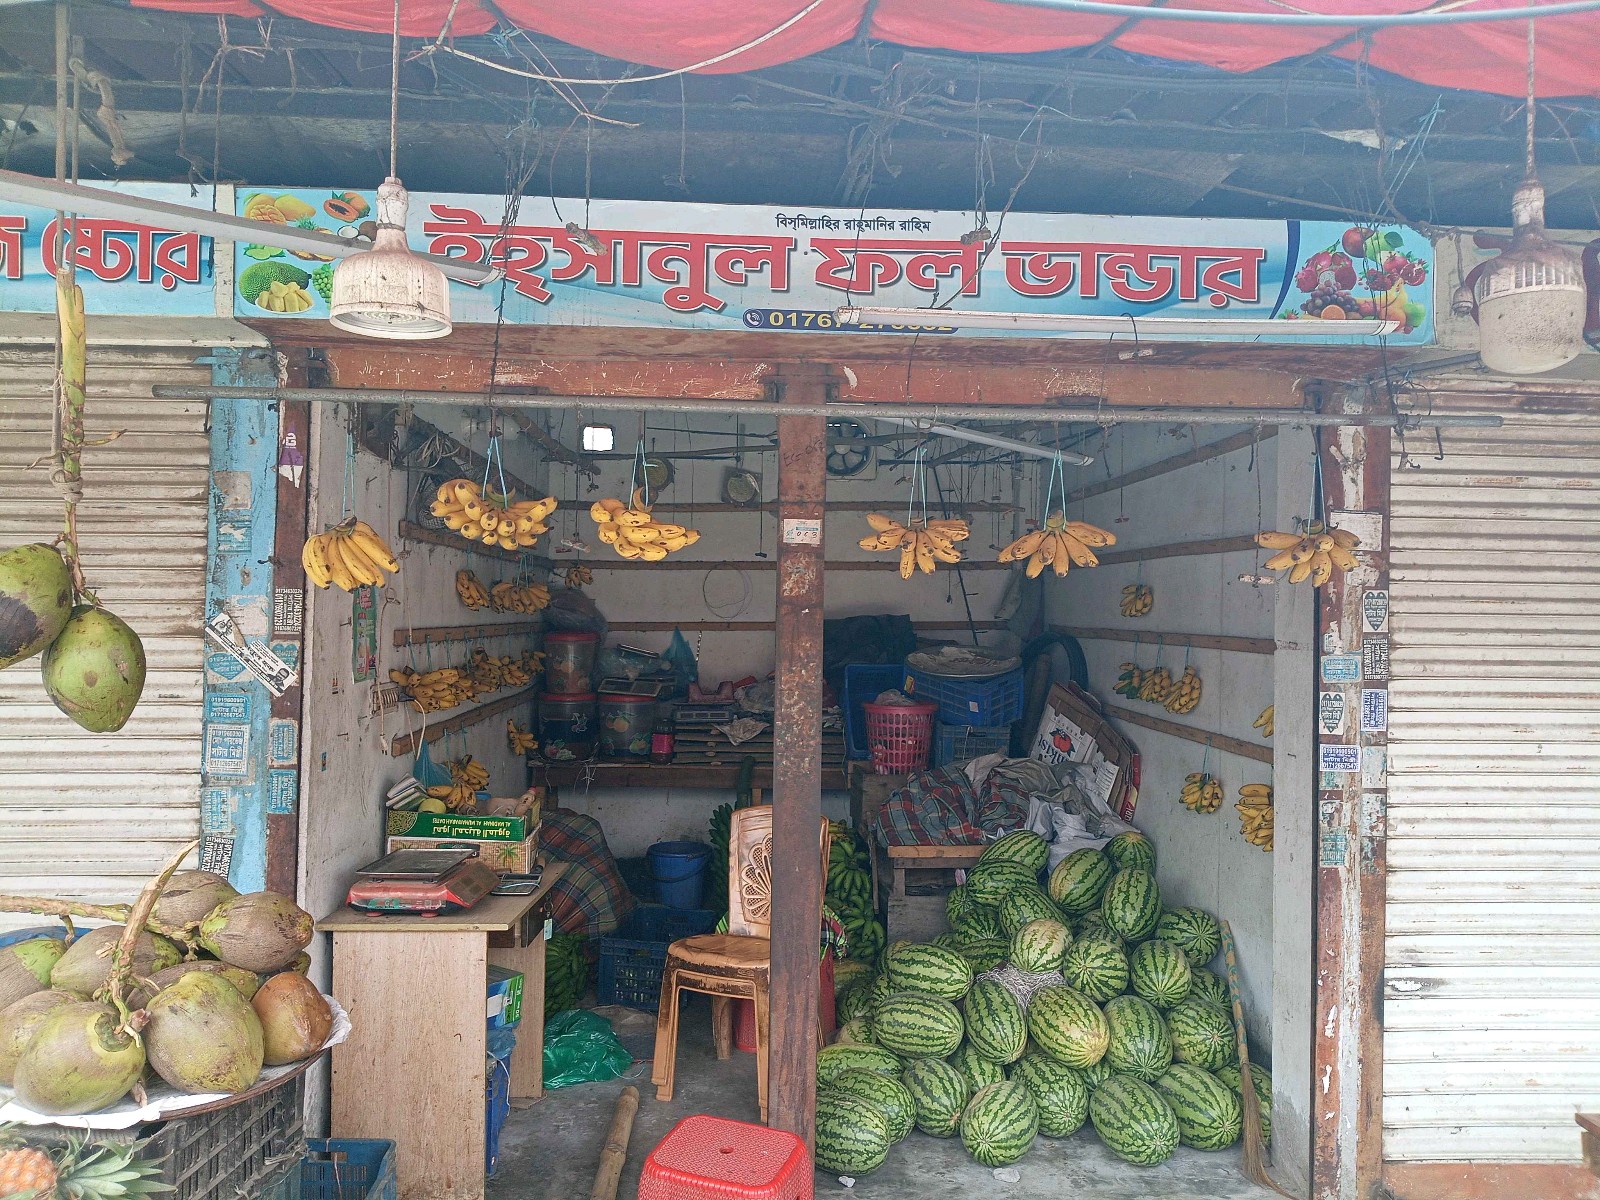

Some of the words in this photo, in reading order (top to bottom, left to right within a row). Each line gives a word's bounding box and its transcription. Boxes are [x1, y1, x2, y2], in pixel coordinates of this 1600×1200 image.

[898, 217, 931, 233] রাহিম
[810, 237, 986, 297] ফল
[1001, 241, 1264, 307] ভান্ডার
